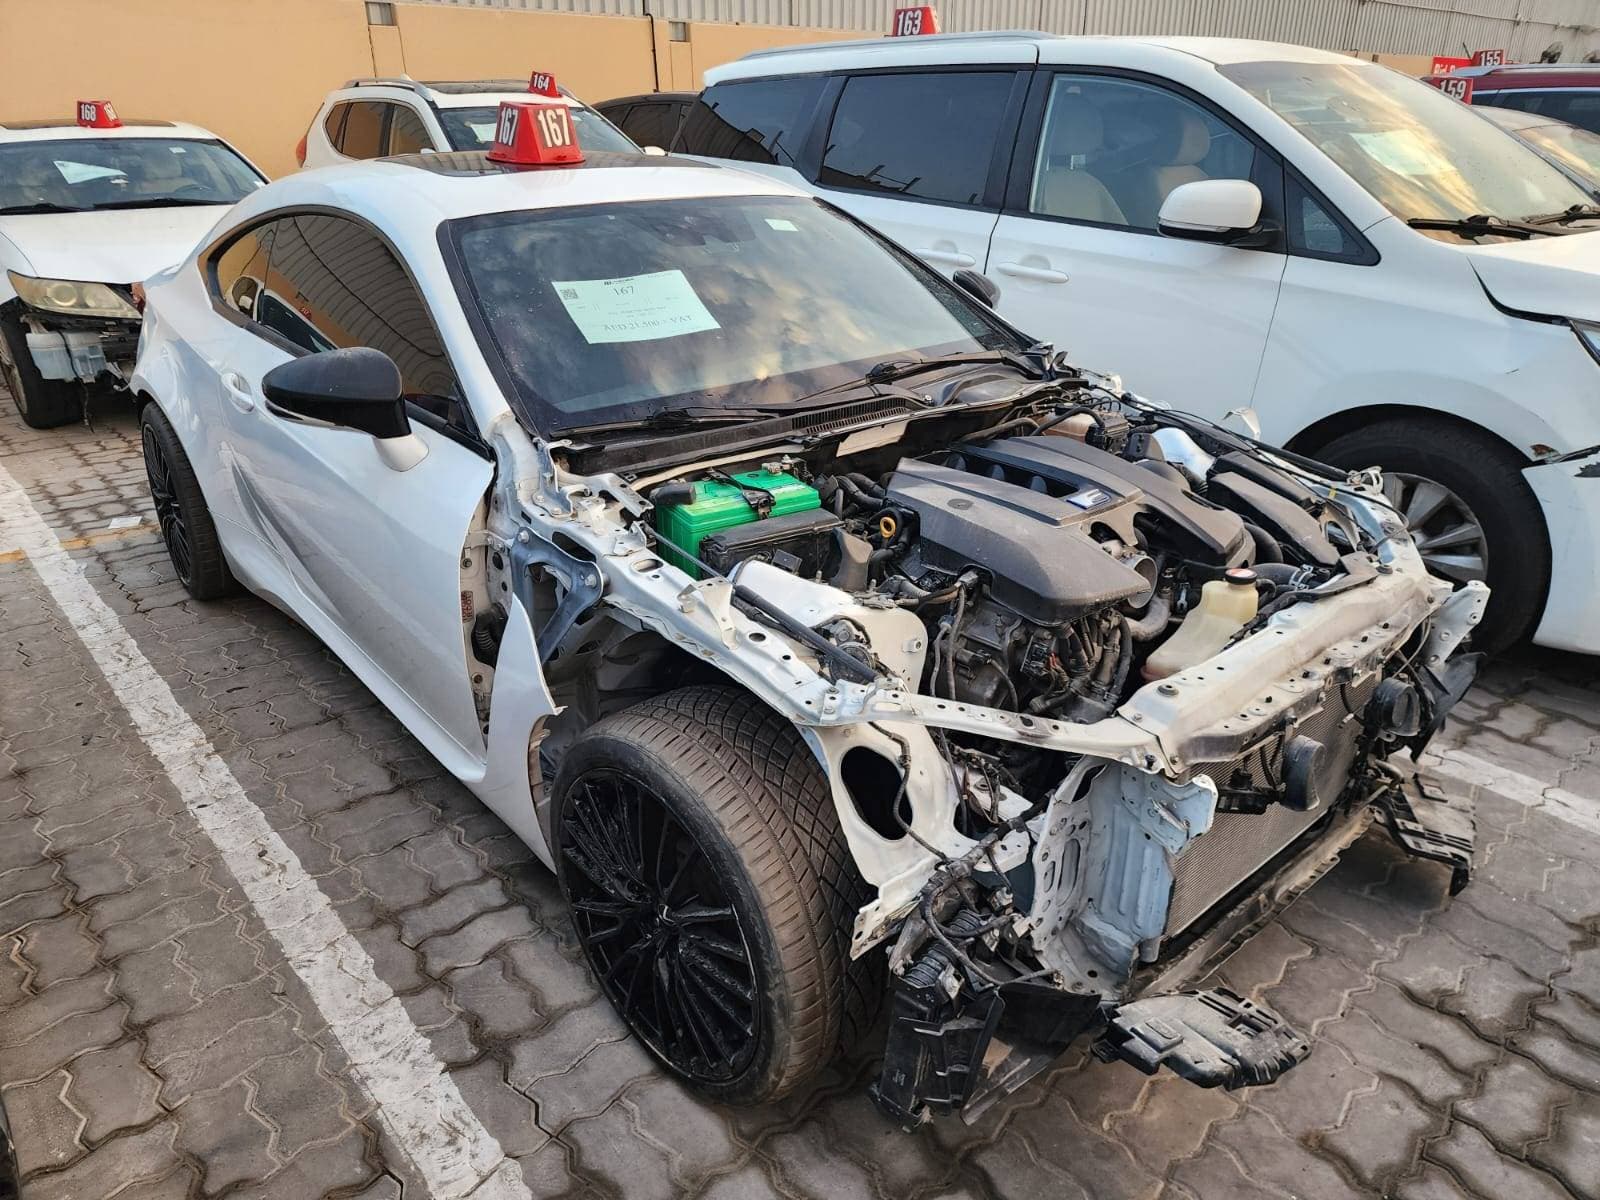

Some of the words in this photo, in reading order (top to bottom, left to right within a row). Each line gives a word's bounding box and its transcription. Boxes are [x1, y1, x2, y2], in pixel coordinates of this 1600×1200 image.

[897, 9, 922, 36] 163
[1480, 51, 1501, 66] 155
[533, 73, 550, 91] 164
[1440, 79, 1467, 99] 159
[80, 103, 97, 121] 168
[498, 106, 519, 146] 167
[537, 108, 571, 148] 167
[613, 285, 634, 296] 167
